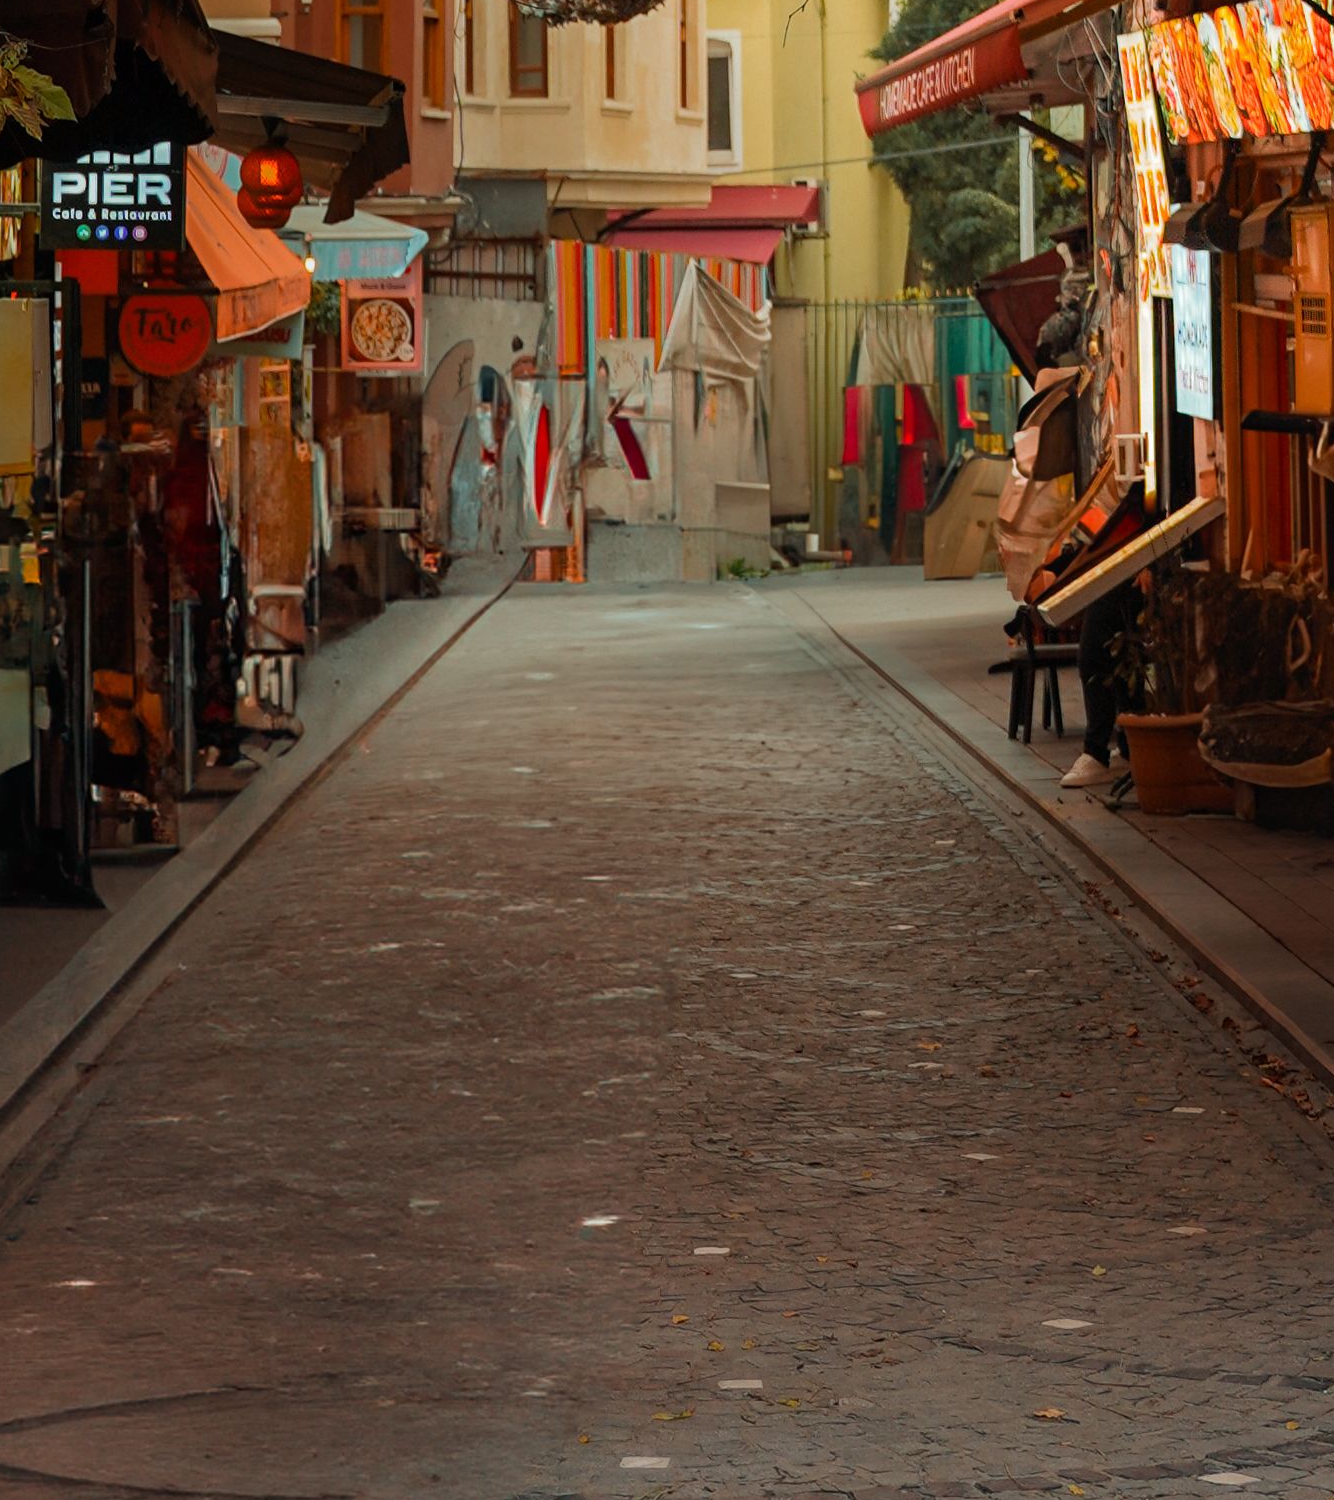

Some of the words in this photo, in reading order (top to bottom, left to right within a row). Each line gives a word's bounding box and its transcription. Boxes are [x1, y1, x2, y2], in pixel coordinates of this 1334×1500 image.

[880, 73, 917, 121] HOMEMADE
[917, 65, 935, 108] CAFE
[935, 62, 941, 99] &
[941, 47, 975, 97] KITCHEN
[53, 172, 172, 205] PIER
[53, 208, 83, 219] Cafe
[88, 209, 96, 219] &
[102, 208, 172, 221] Restaurant
